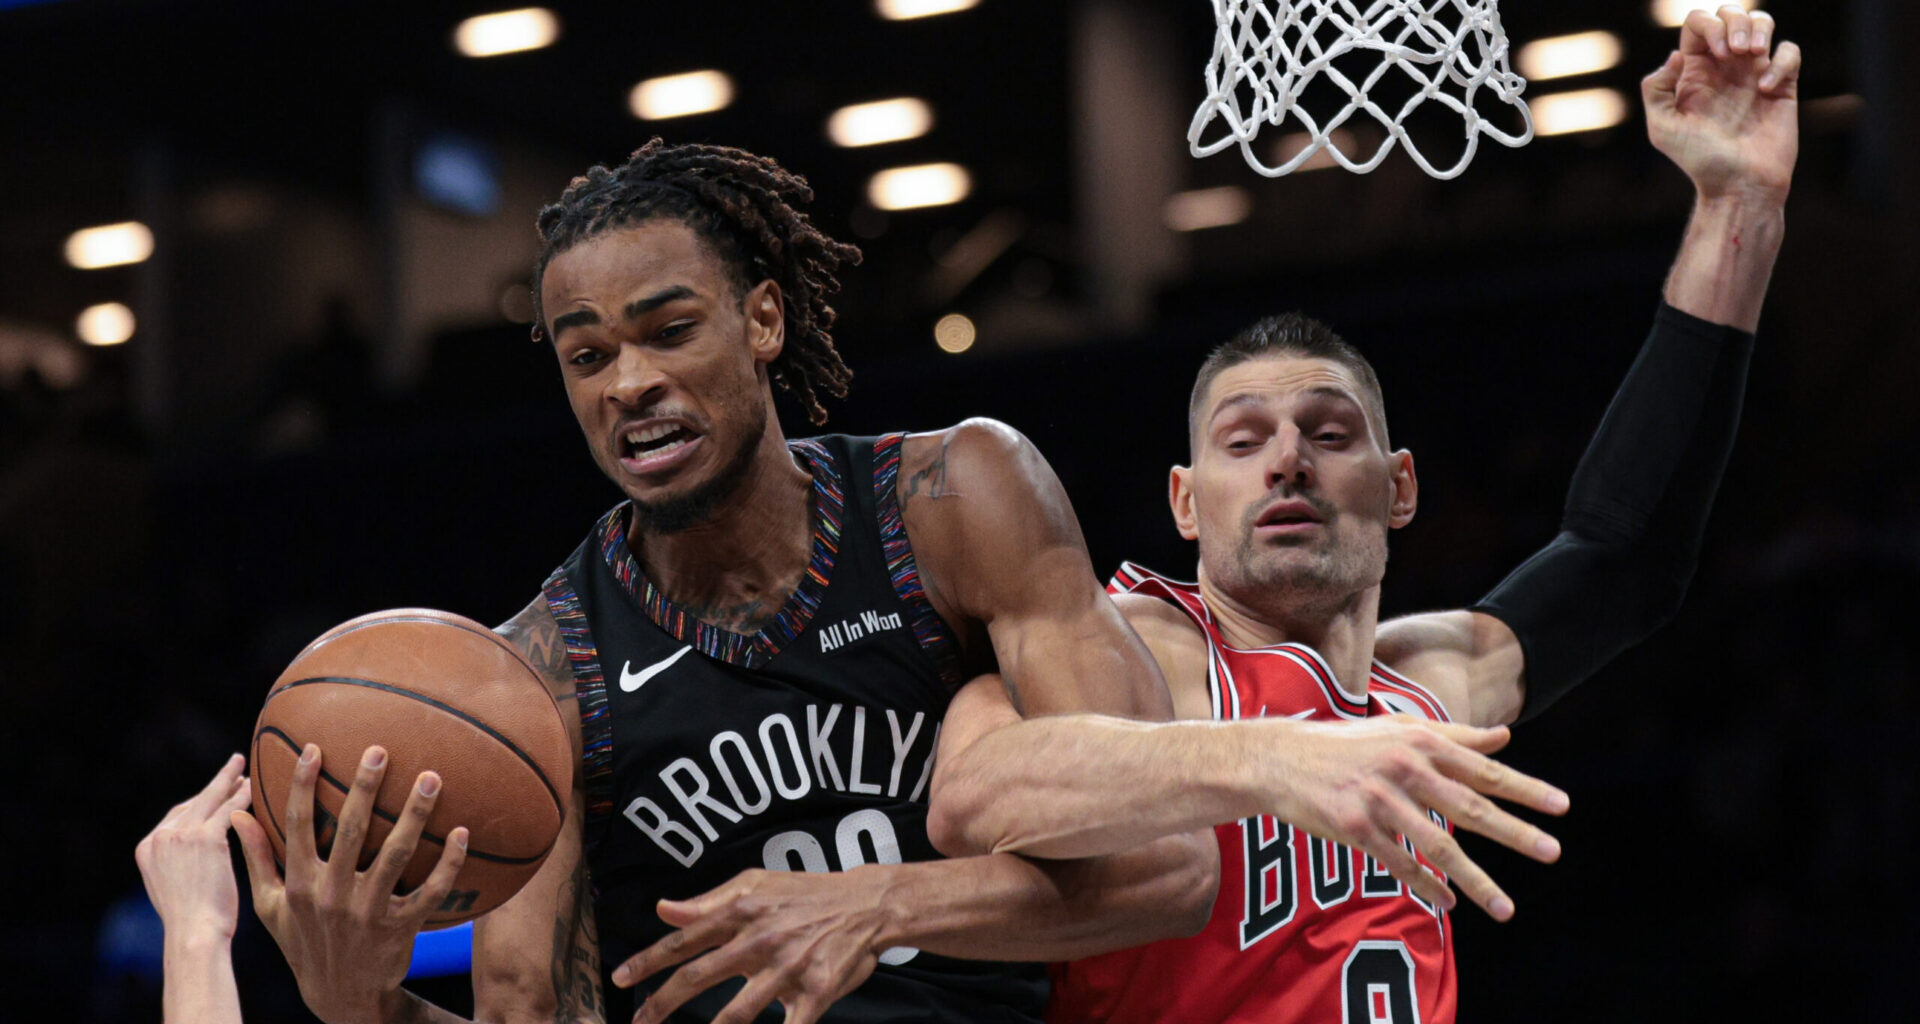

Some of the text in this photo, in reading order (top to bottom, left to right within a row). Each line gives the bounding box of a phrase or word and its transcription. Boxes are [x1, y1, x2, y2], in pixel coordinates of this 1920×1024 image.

[819, 610, 902, 653] All In Won
[622, 703, 941, 868] BROOKLY
